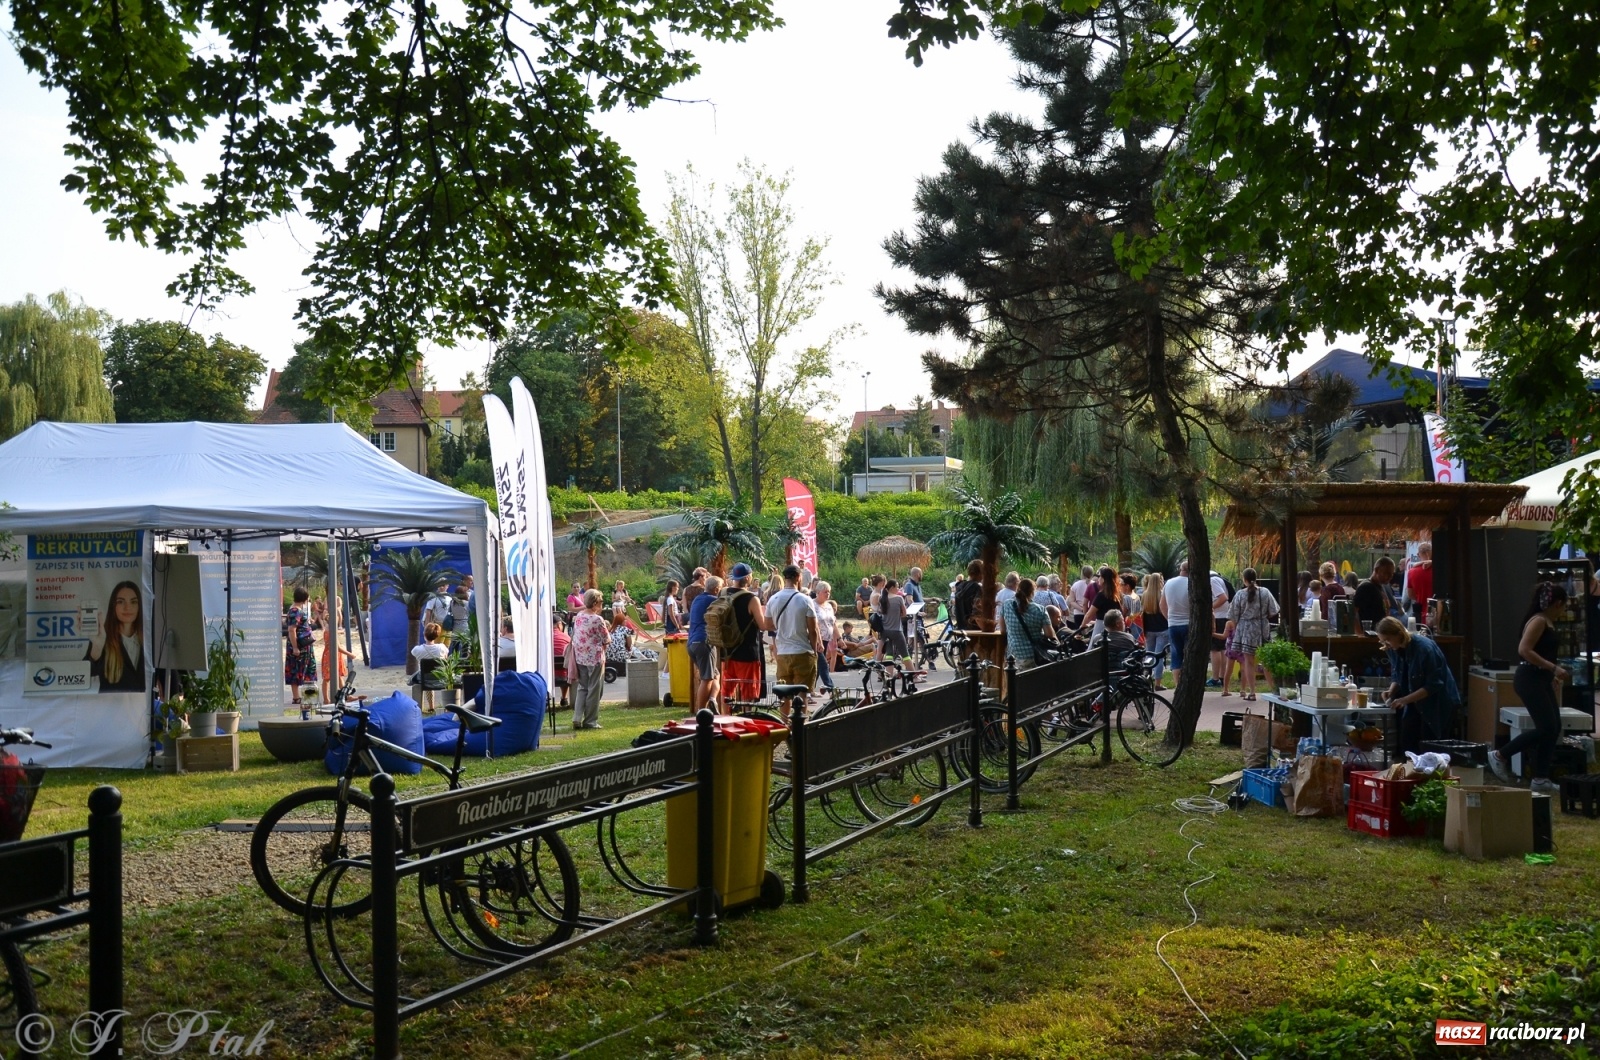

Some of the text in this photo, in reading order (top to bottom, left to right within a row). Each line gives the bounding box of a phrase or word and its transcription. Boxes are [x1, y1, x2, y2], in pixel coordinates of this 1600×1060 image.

[1507, 505, 1558, 521] RACIBORS
[35, 540, 137, 556] REKRUTACJI
[35, 560, 139, 571] ZAPISZ SIĘ NA STUDIA
[40, 575, 85, 583] smartphone
[40, 593, 76, 601] komputer
[36, 615, 76, 638] SiR
[58, 674, 85, 683] PWSZ
[457, 758, 666, 825] Racibórz przyjazny rowerzystom
